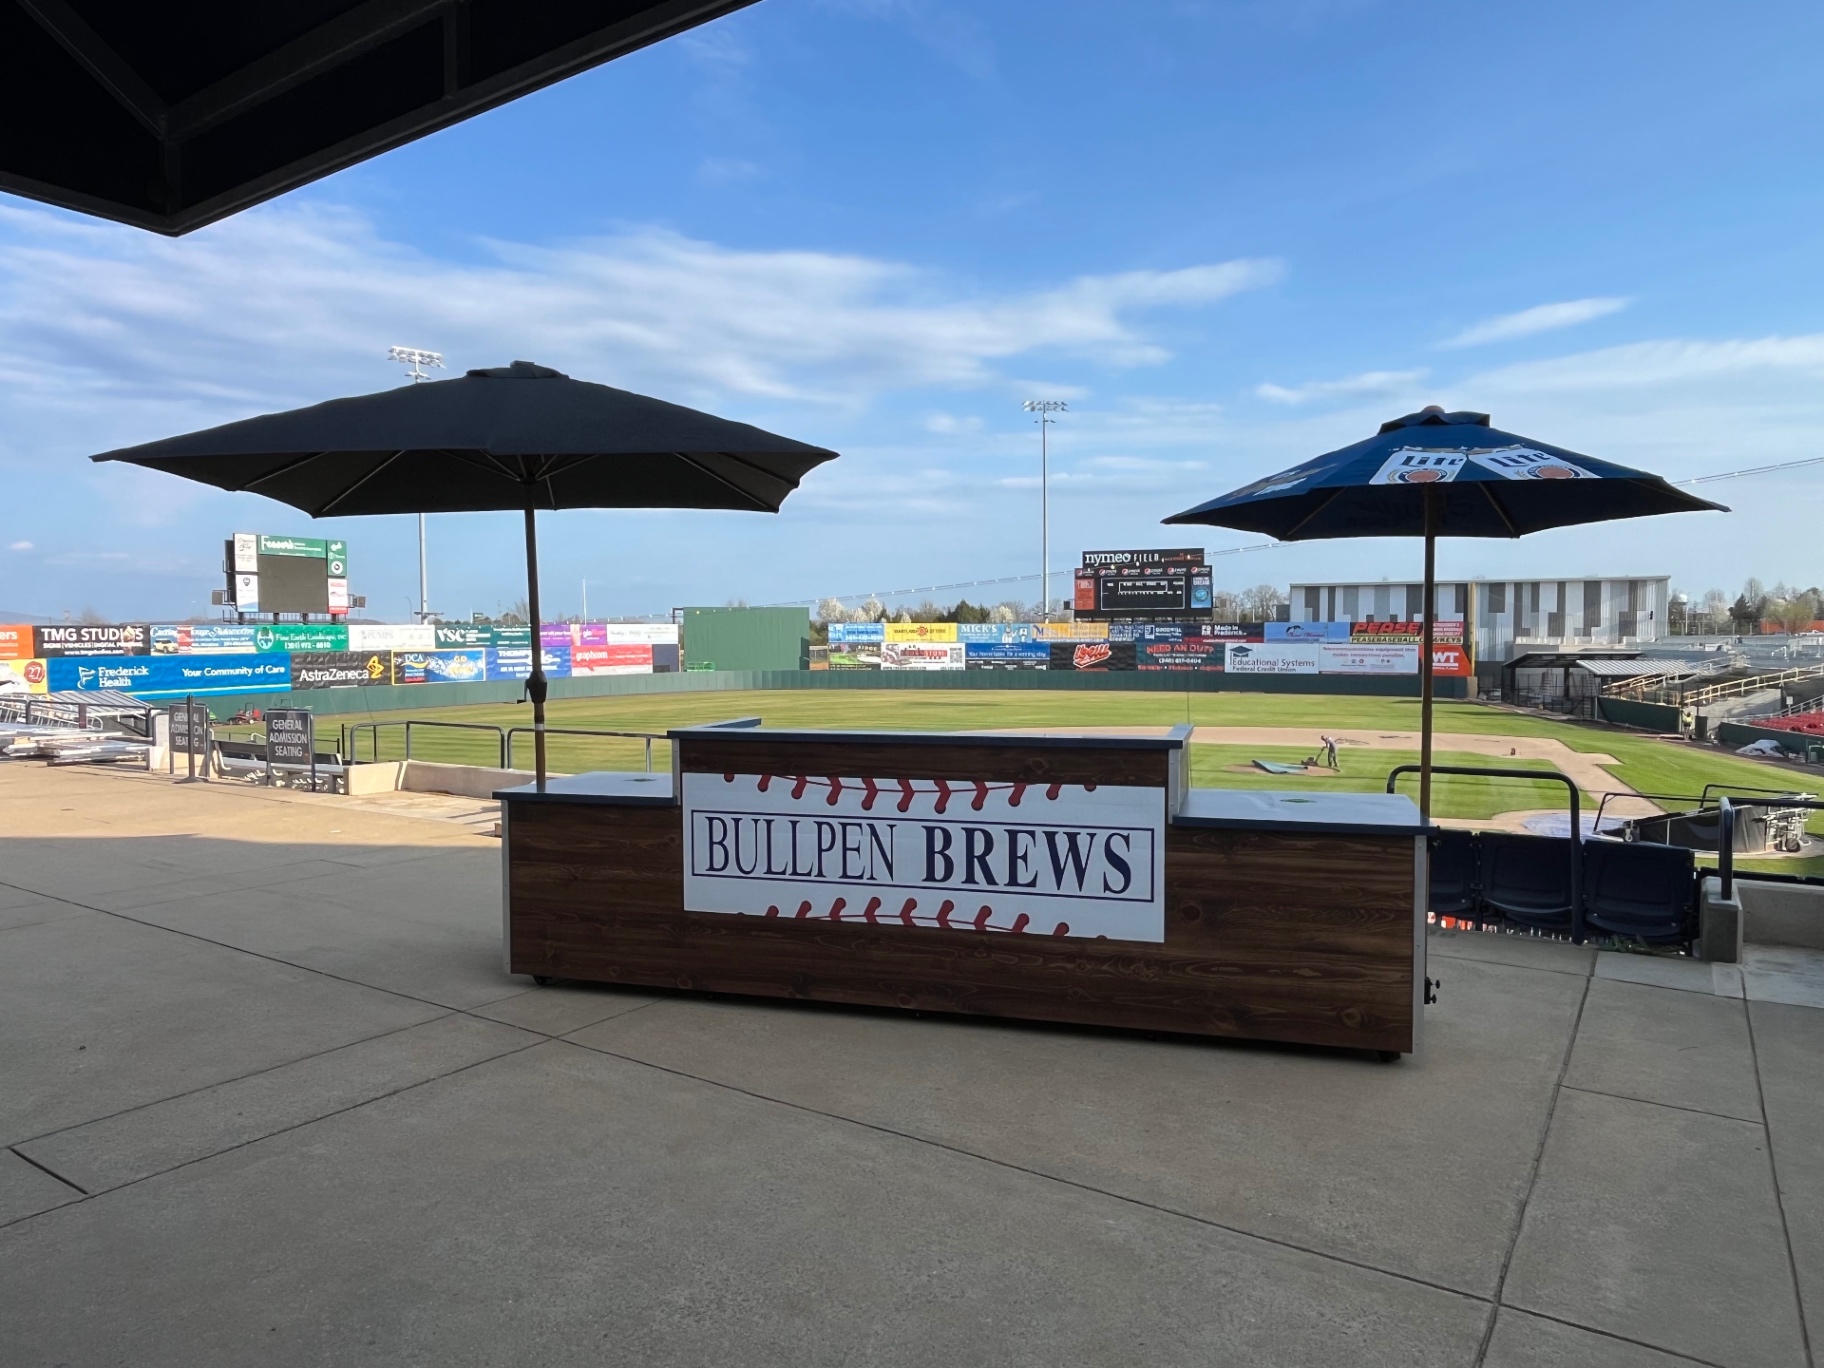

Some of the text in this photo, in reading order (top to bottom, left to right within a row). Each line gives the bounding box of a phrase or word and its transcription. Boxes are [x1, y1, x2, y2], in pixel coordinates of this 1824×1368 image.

[1400, 455, 1463, 466] Lite
[1486, 451, 1551, 468] Lite
[1084, 553, 1132, 566] nymeo
[1133, 553, 1159, 562] FIELD
[40, 628, 144, 641] TMG STUDIS
[960, 624, 998, 633] MICK'S
[1353, 622, 1419, 635] PEASE
[437, 629, 466, 642] VSC
[1146, 645, 1172, 654] NEED
[1173, 644, 1188, 652] AN
[404, 653, 424, 663] DCA
[1232, 658, 1315, 668] Educational Systems
[98, 666, 149, 677] Frederick
[182, 665, 286, 677] Your Community of Care
[300, 669, 369, 682] AstraZeneca
[98, 677, 132, 688] Health
[174, 711, 200, 723] GENAL
[272, 719, 303, 731] GENERAL
[175, 735, 200, 747] SEATG
[269, 731, 308, 744] ADMISSION
[274, 745, 303, 757] SEATING
[705, 815, 1133, 894] BULLPEN BREWS
